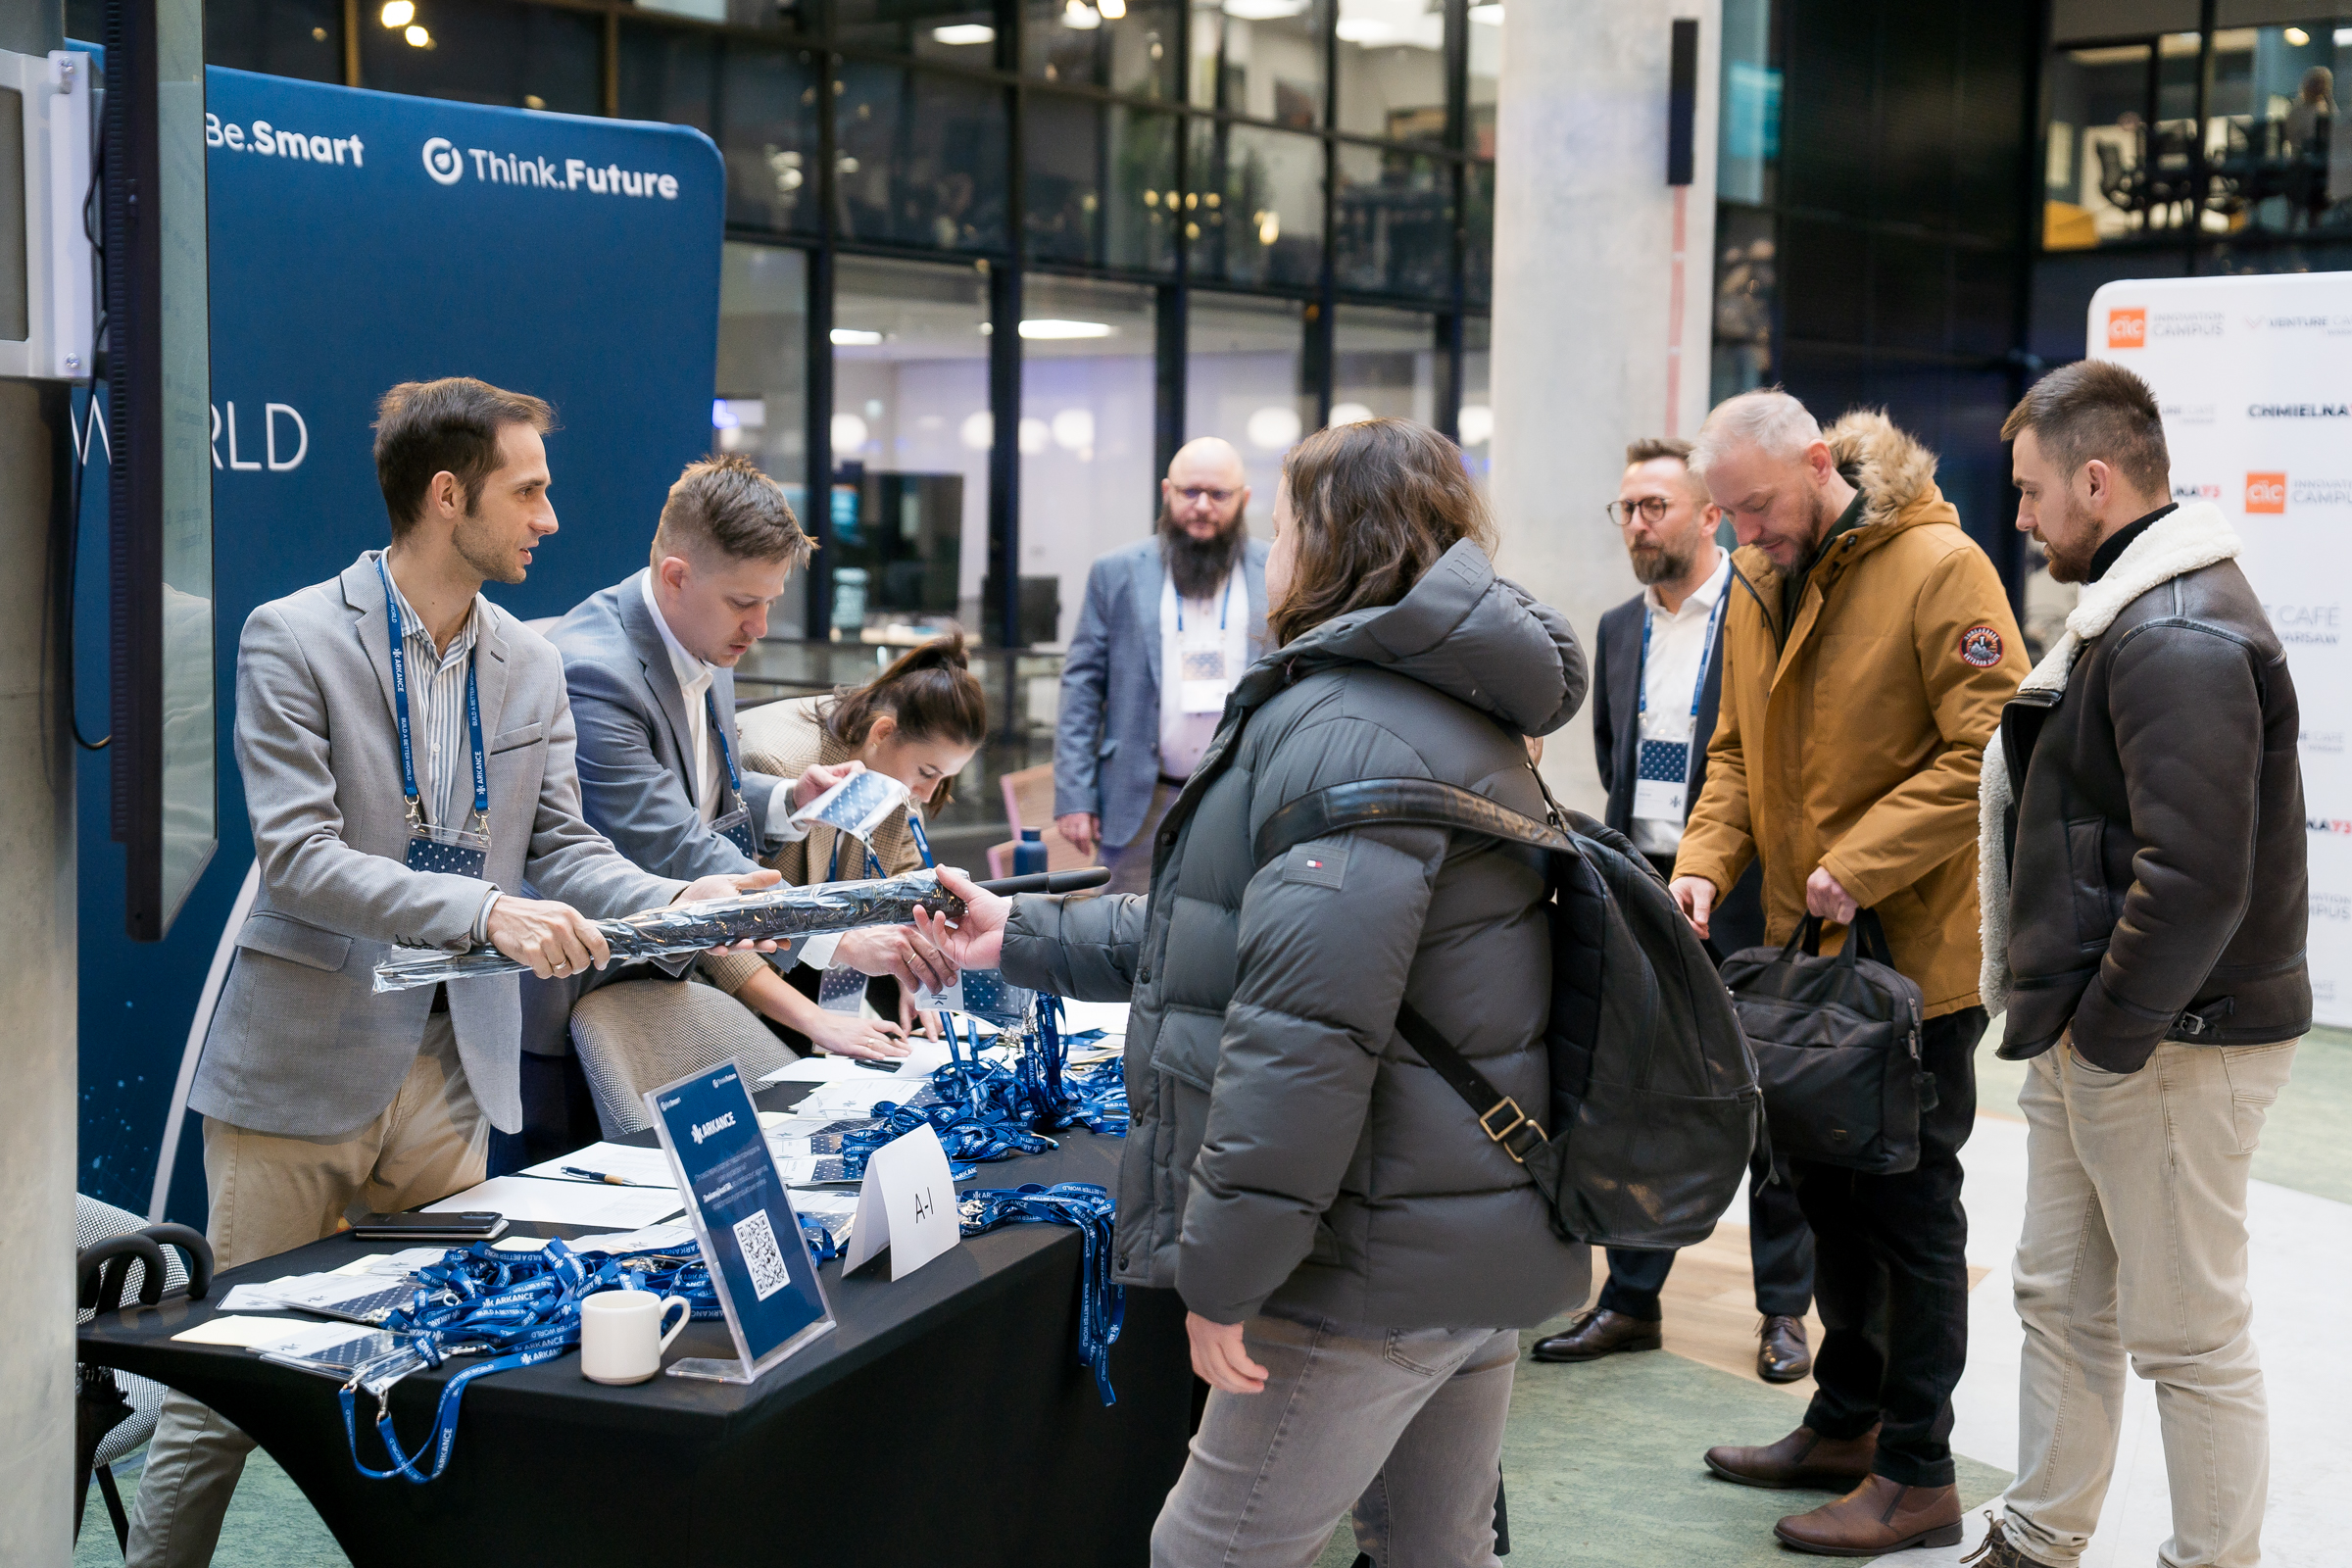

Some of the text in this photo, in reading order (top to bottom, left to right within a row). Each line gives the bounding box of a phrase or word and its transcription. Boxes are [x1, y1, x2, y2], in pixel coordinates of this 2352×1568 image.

[206, 112, 365, 168] Be.Smart
[468, 147, 680, 199] Think.Future
[2154, 322, 2226, 337] CAMPUS
[2277, 600, 2340, 627] CAFÉ
[395, 657, 405, 693] ARKANCE
[476, 751, 485, 785] ARKANCE
[701, 1110, 737, 1140] ARKANCE
[495, 1293, 535, 1306] ARKANCE
[524, 1335, 564, 1350] ARKANCE
[531, 1328, 556, 1339] WORLD
